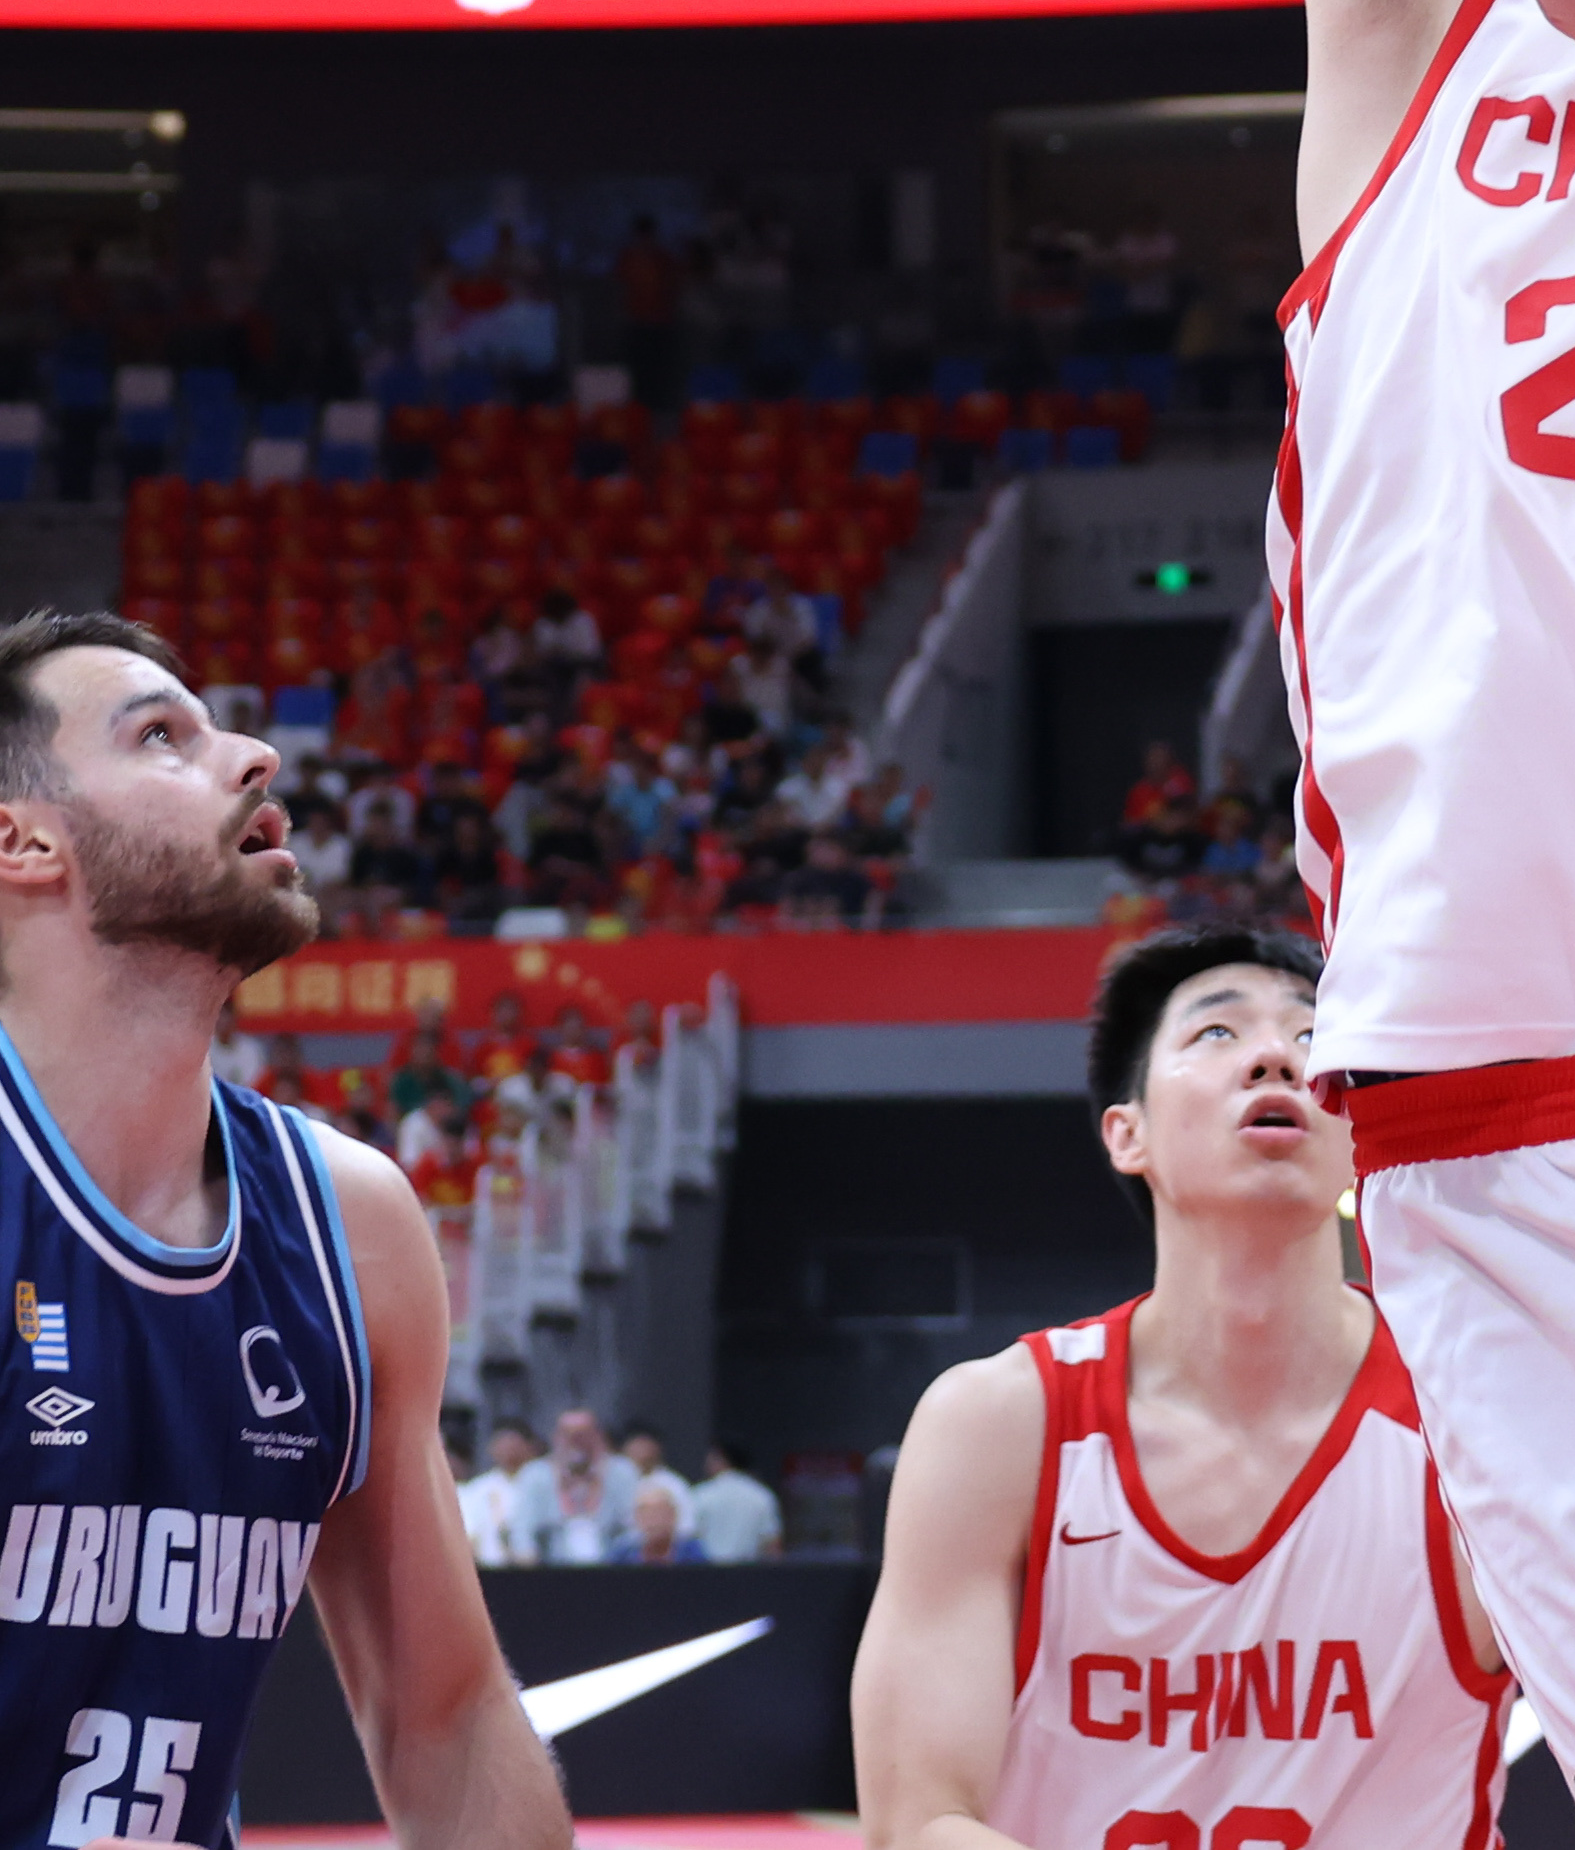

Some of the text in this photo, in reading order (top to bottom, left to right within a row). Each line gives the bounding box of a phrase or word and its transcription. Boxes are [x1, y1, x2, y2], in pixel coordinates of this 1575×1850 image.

[30, 1426, 89, 1446] umbro
[0, 1504, 321, 1640] URUGUAY
[1069, 1639, 1375, 1753] CHINA
[47, 1707, 202, 1850] 25
